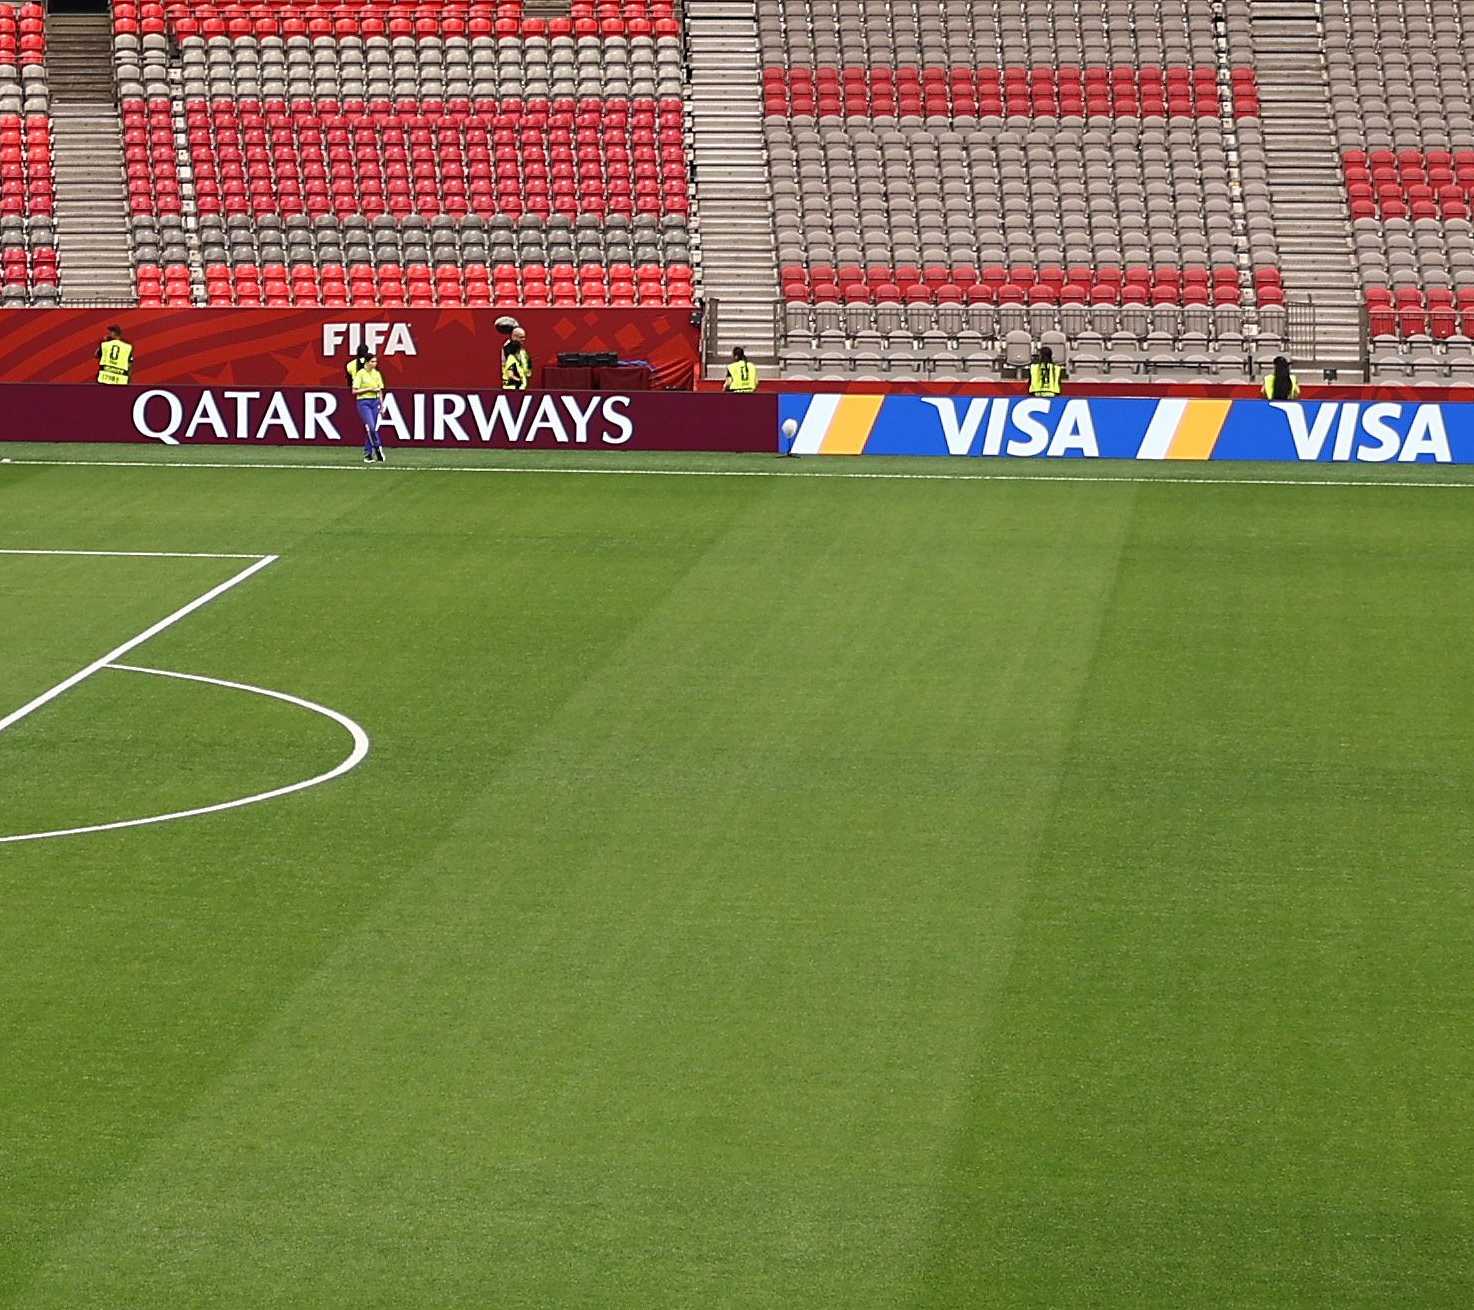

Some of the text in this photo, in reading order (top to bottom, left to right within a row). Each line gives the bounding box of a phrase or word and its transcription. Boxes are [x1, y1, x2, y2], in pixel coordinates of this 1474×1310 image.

[322, 321, 418, 357] FIFA
[132, 389, 633, 446] QATAR AIRWAYS
[921, 397, 1100, 457] VISA
[1268, 401, 1452, 462] VISA
